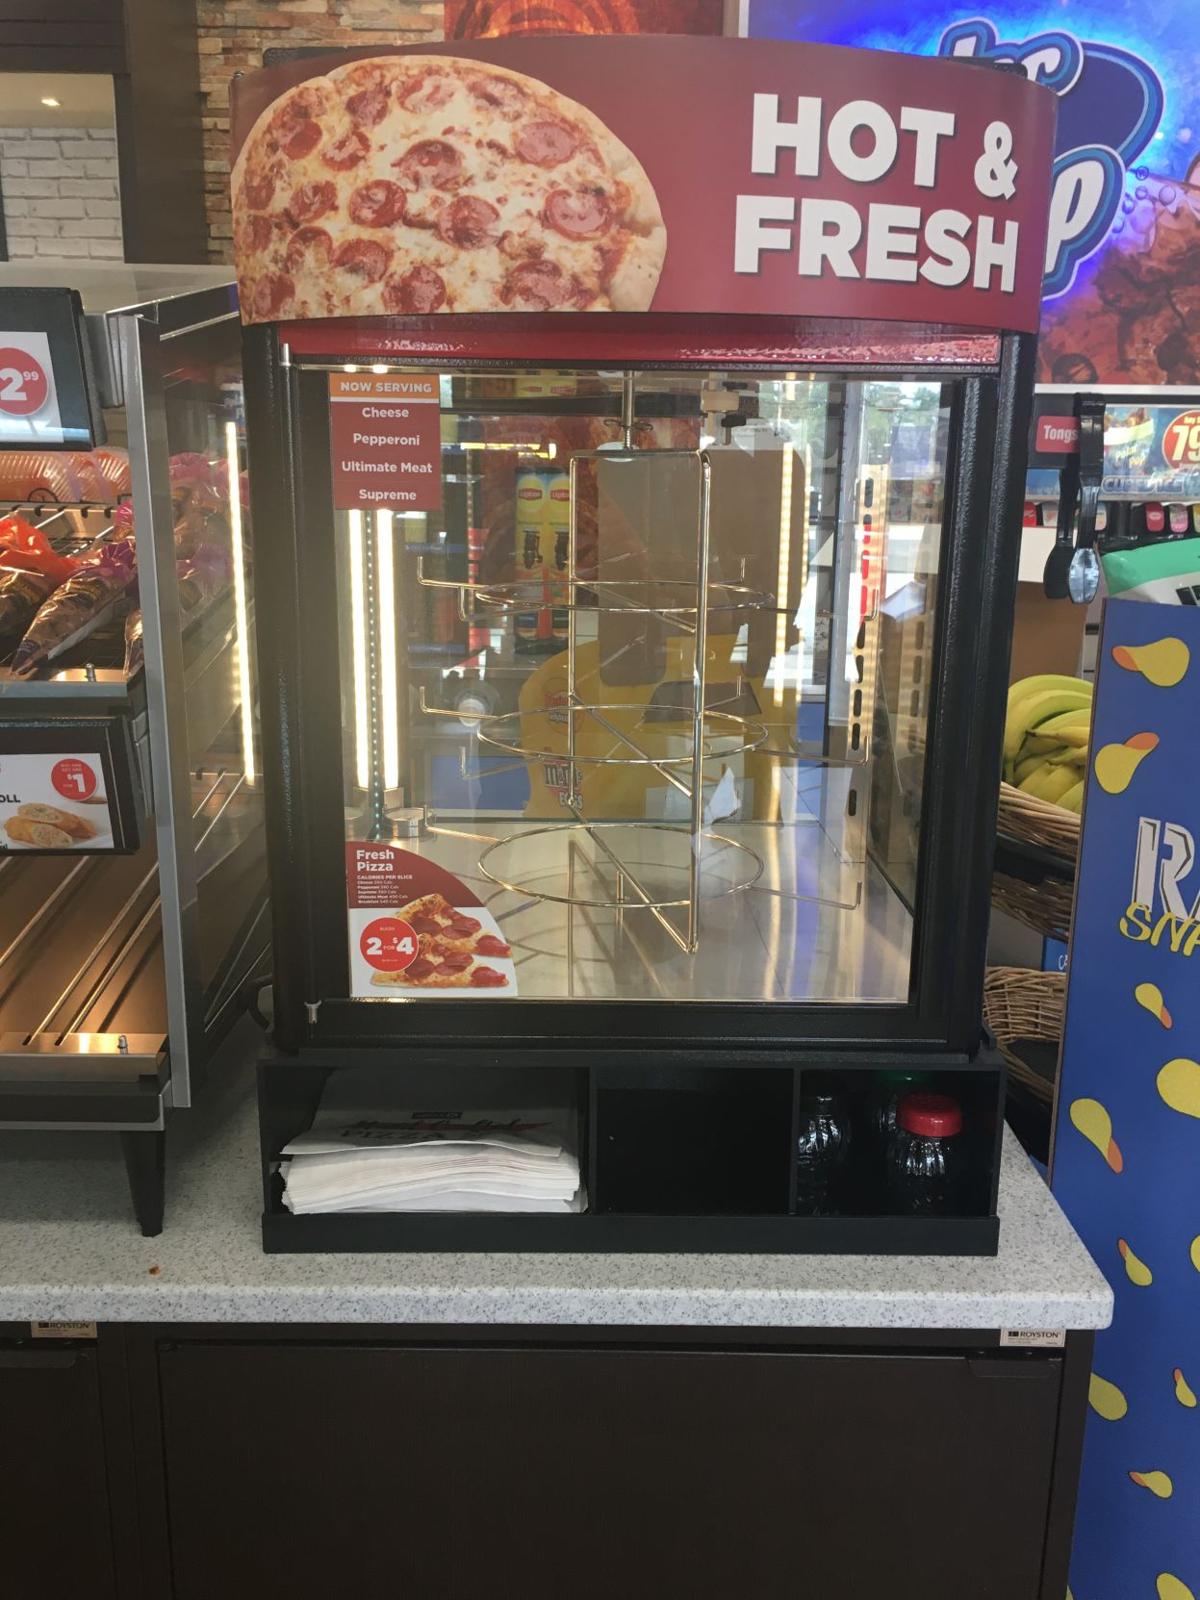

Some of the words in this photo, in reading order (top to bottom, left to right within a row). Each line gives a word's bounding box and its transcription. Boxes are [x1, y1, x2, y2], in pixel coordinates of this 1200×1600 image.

[751, 93, 955, 187] HOT
[974, 121, 1018, 199] &
[734, 195, 1019, 292] FRESH
[341, 382, 371, 392] NOW
[376, 382, 432, 392] SERVING
[362, 407, 409, 418] Cheese
[353, 433, 420, 446] Pepperoni
[1043, 425, 1078, 443] Tongs
[342, 461, 397, 472] Ultimate
[401, 462, 433, 473] Meat
[359, 489, 417, 501] Supreme
[356, 849, 395, 860] Fresh
[356, 861, 394, 872] Pizza
[366, 936, 383, 955] 2
[1020, 1330, 1060, 1339] ROYSTON
